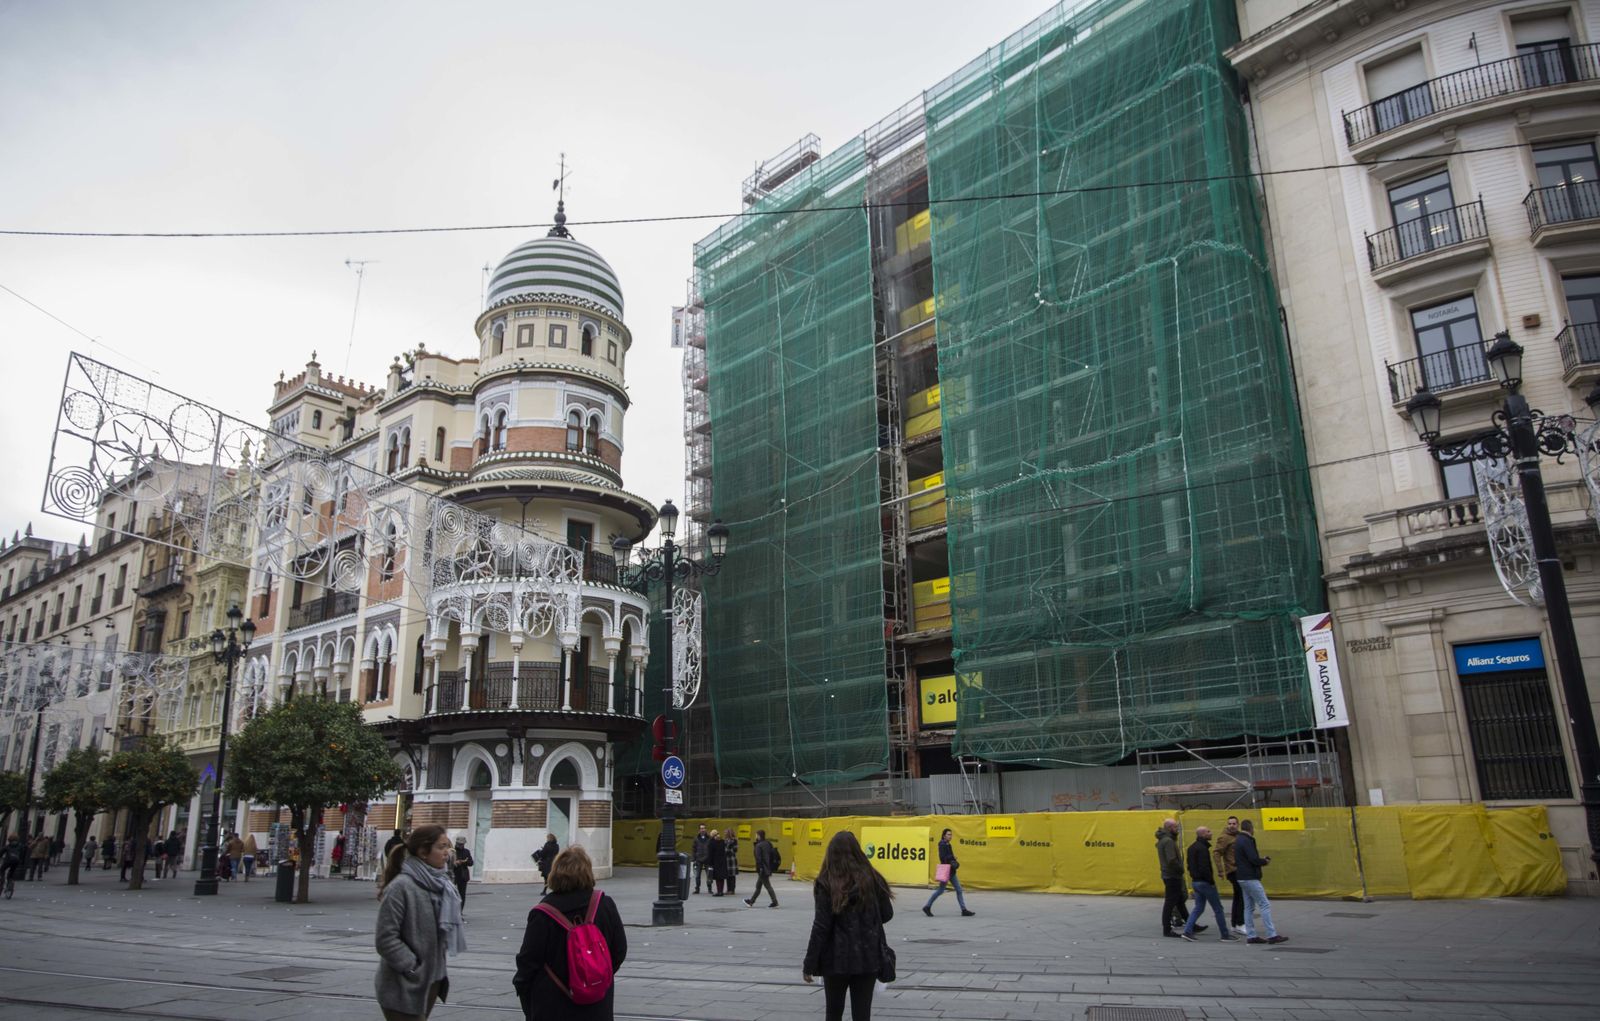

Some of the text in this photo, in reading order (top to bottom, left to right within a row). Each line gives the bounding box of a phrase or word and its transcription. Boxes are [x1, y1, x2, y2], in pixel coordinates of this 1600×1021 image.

[1467, 654, 1530, 666] Allianz Seguros
[1318, 664, 1336, 721] ALQUIANSA
[1025, 840, 1050, 848] aldesa
[1091, 840, 1115, 848] aldesa
[876, 842, 926, 861] aldesa
